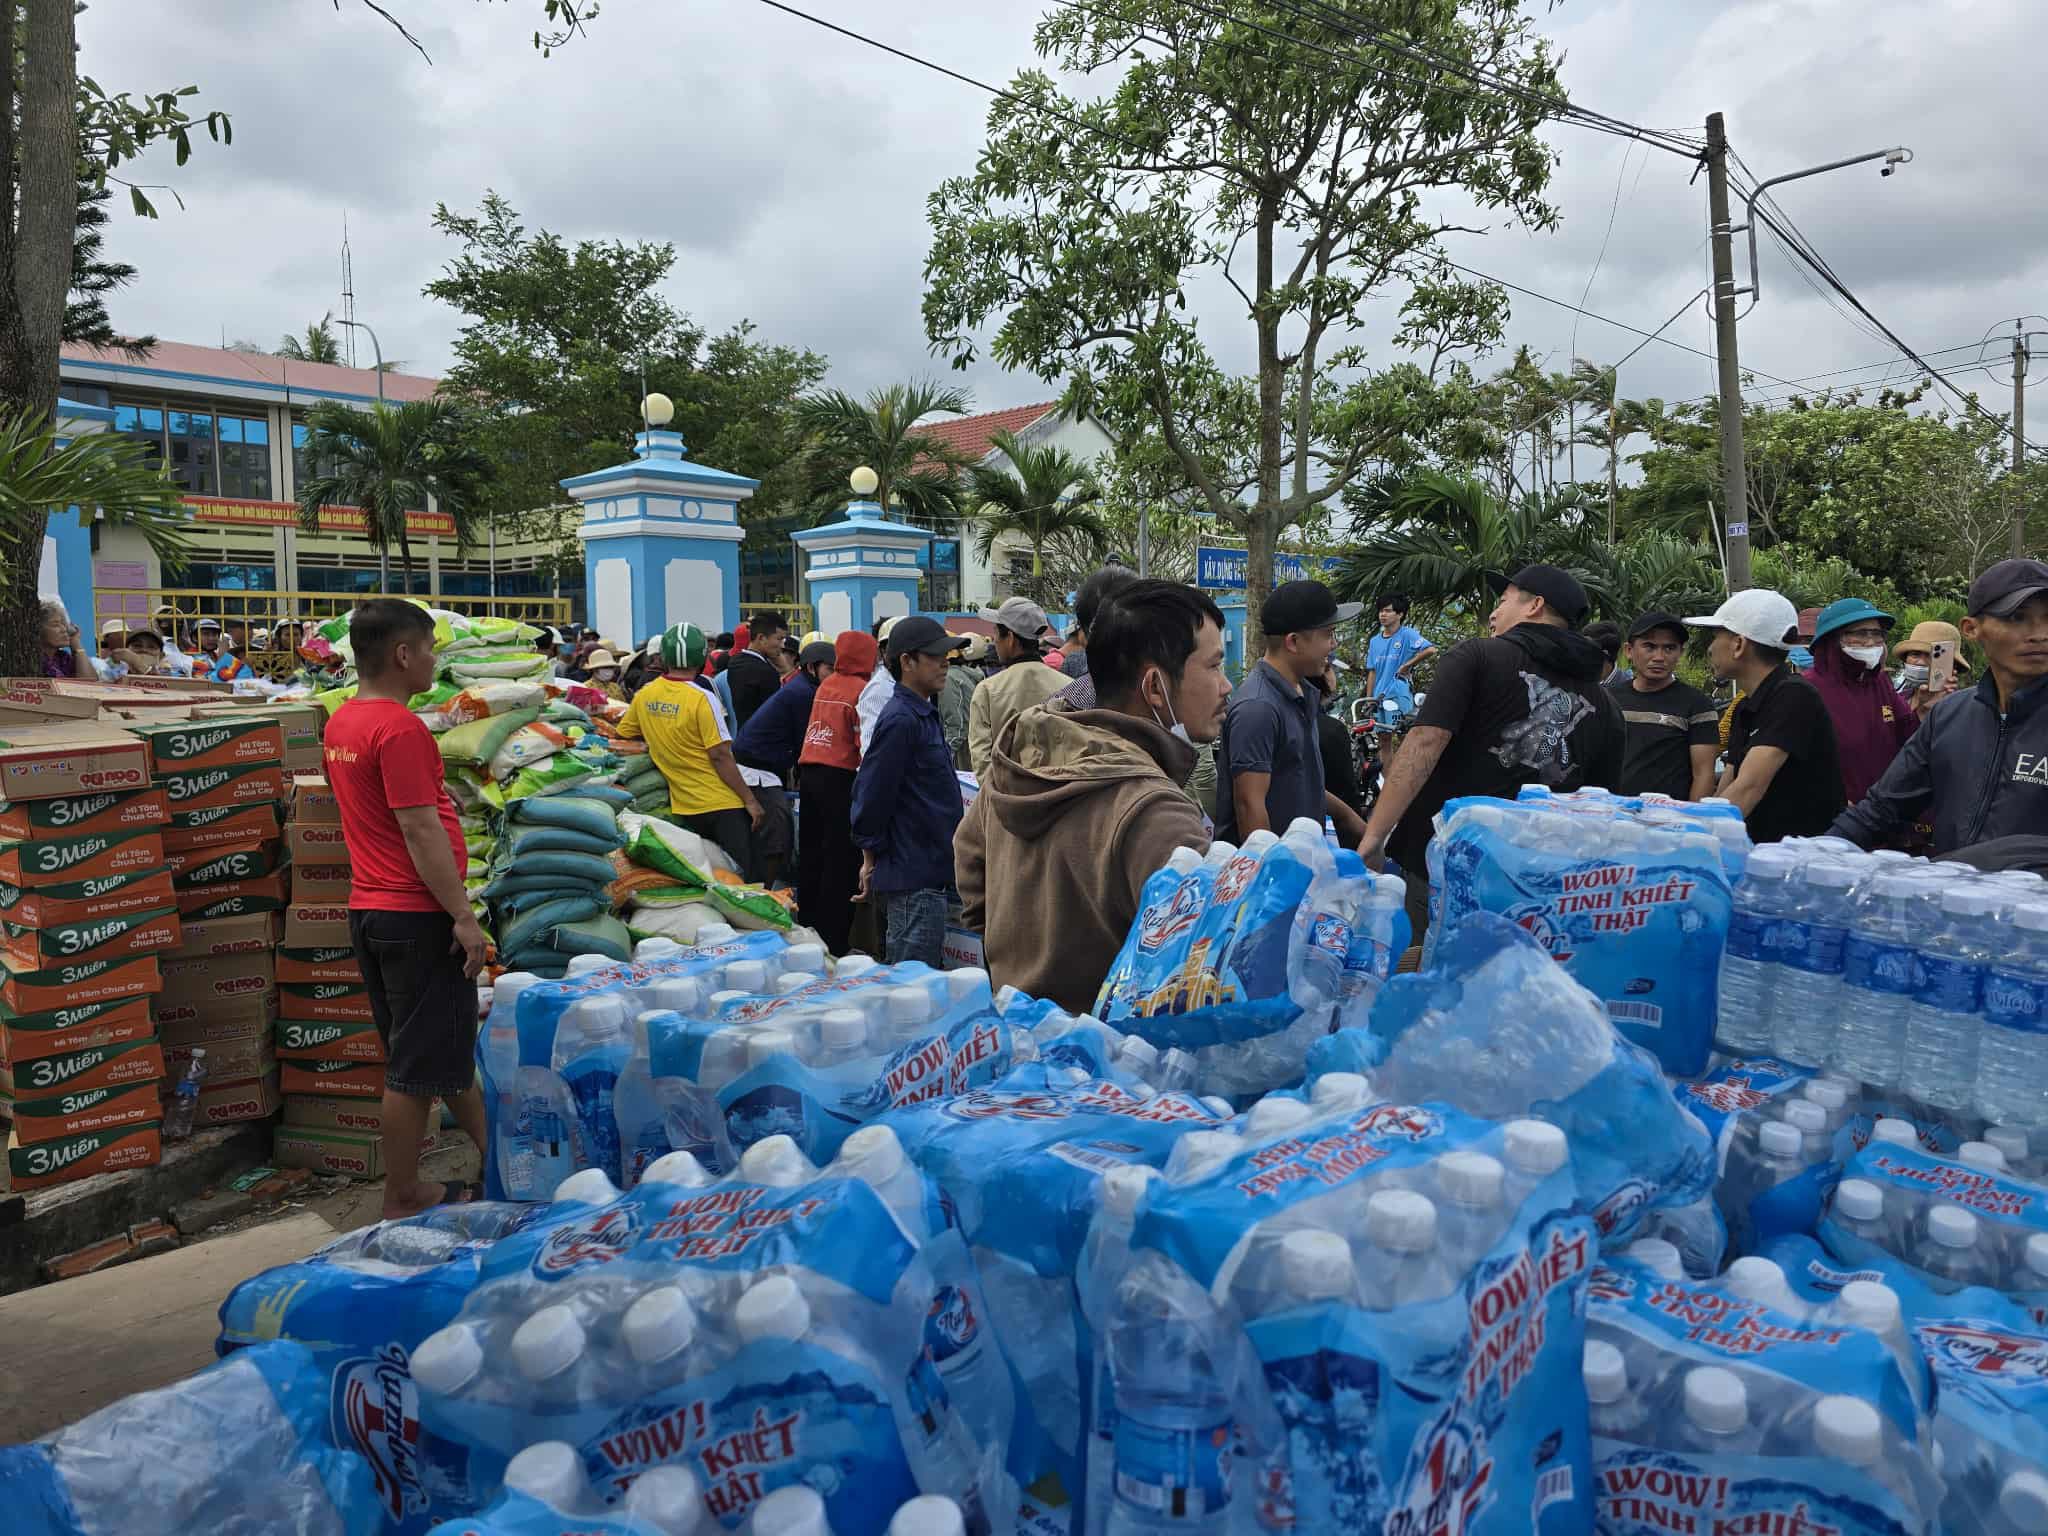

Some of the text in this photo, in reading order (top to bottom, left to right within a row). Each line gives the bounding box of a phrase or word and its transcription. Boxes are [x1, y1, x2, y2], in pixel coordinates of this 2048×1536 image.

[1557, 875, 1696, 915] TINH KHIẾT
[1563, 866, 1635, 892] WOW!
[1592, 907, 1650, 933] THẬT
[601, 1401, 705, 1467] WOW!
[702, 1407, 799, 1476] KHIẾT
[704, 1471, 762, 1516] HẬT
[1606, 1467, 1729, 1508] WOW!
[1608, 1498, 1697, 1535] TINH
